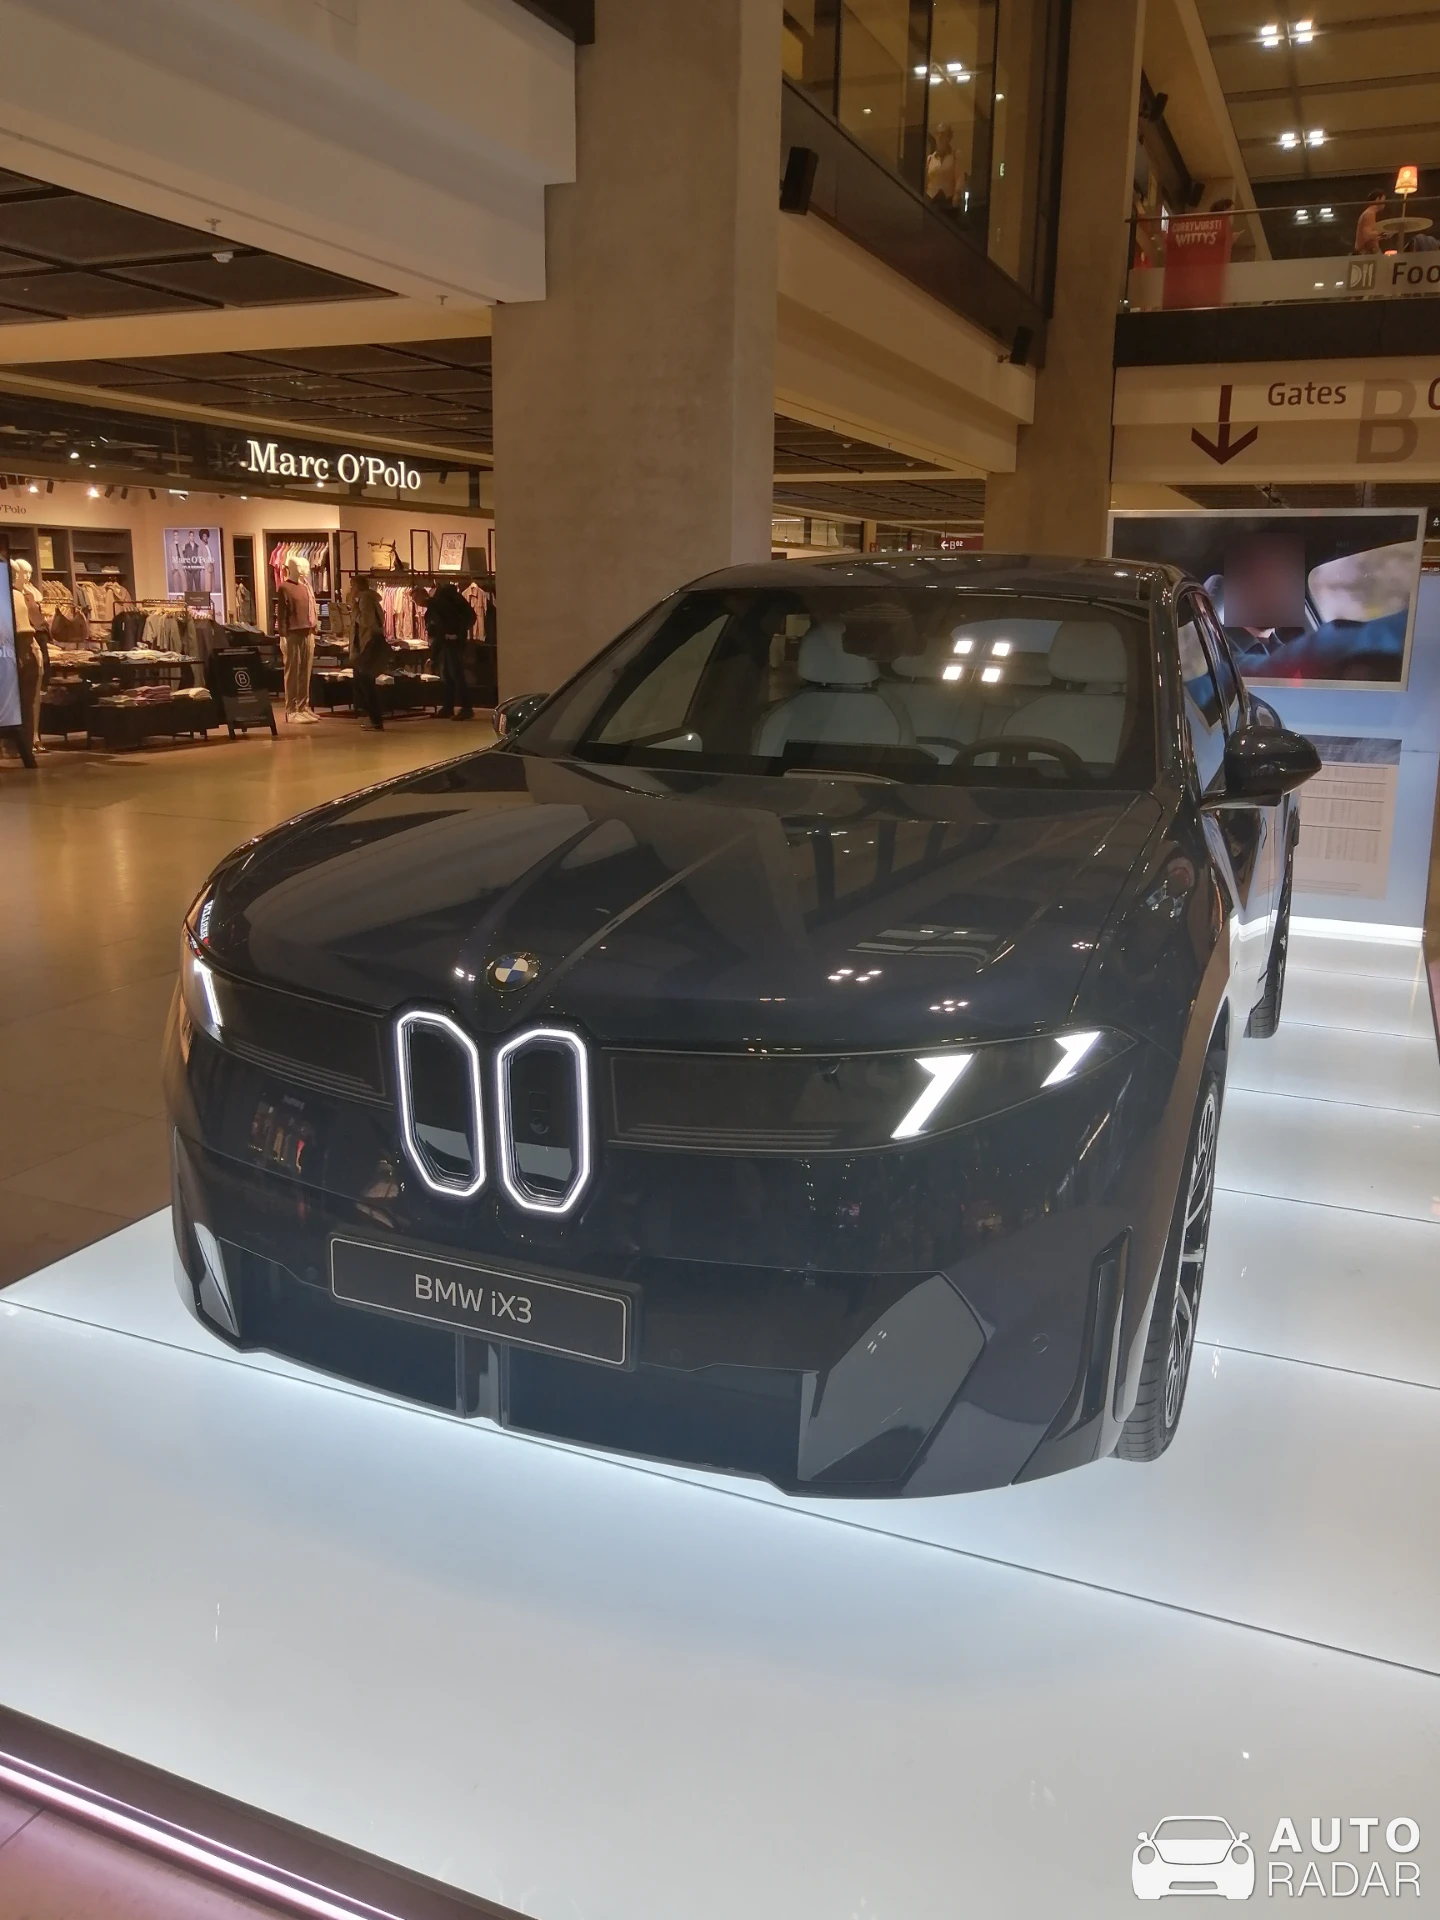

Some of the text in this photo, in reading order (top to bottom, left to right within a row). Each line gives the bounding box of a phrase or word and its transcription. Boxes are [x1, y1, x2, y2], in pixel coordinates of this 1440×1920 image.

[1392, 261, 1440, 284] Foo
[1267, 381, 1347, 406] Gates
[1356, 378, 1418, 464] B
[247, 440, 421, 490] Marc O'Polo
[415, 1273, 532, 1323] BMW iX3
